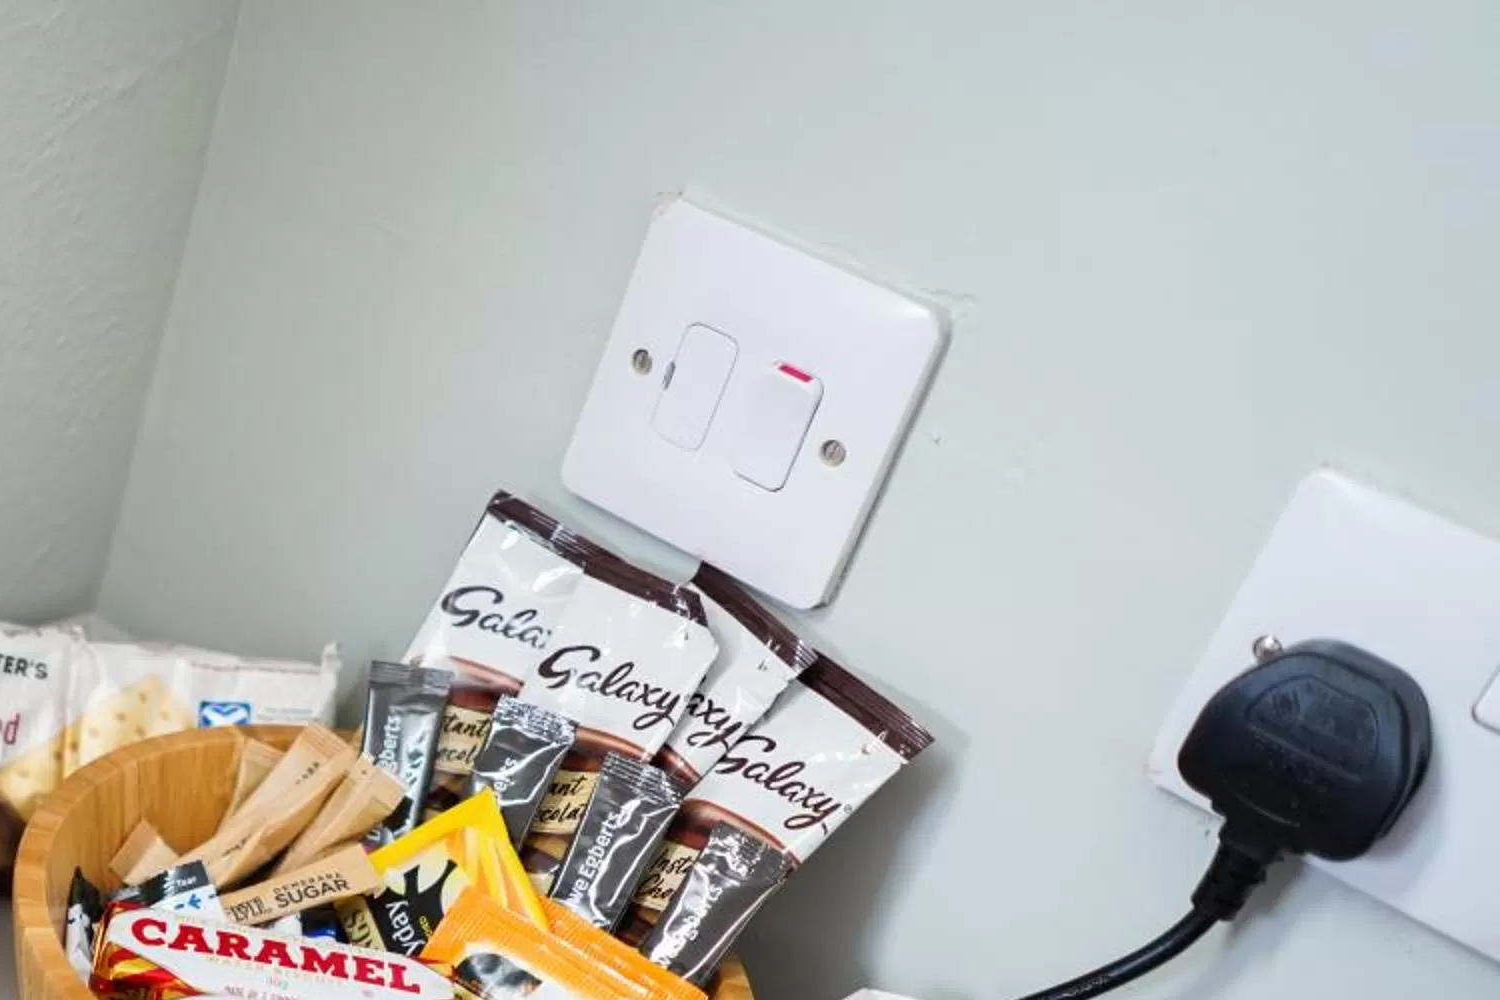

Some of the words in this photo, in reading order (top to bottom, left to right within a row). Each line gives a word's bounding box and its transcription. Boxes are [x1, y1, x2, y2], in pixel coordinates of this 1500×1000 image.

[441, 585, 549, 649] Gala
[538, 645, 684, 731] Galaxy
[376, 715, 402, 769] gberts
[442, 712, 490, 738] tant
[686, 690, 743, 751] axy
[716, 734, 843, 835] Galaxy
[275, 879, 351, 909] SUGAR
[131, 918, 421, 994] CARAMEL
